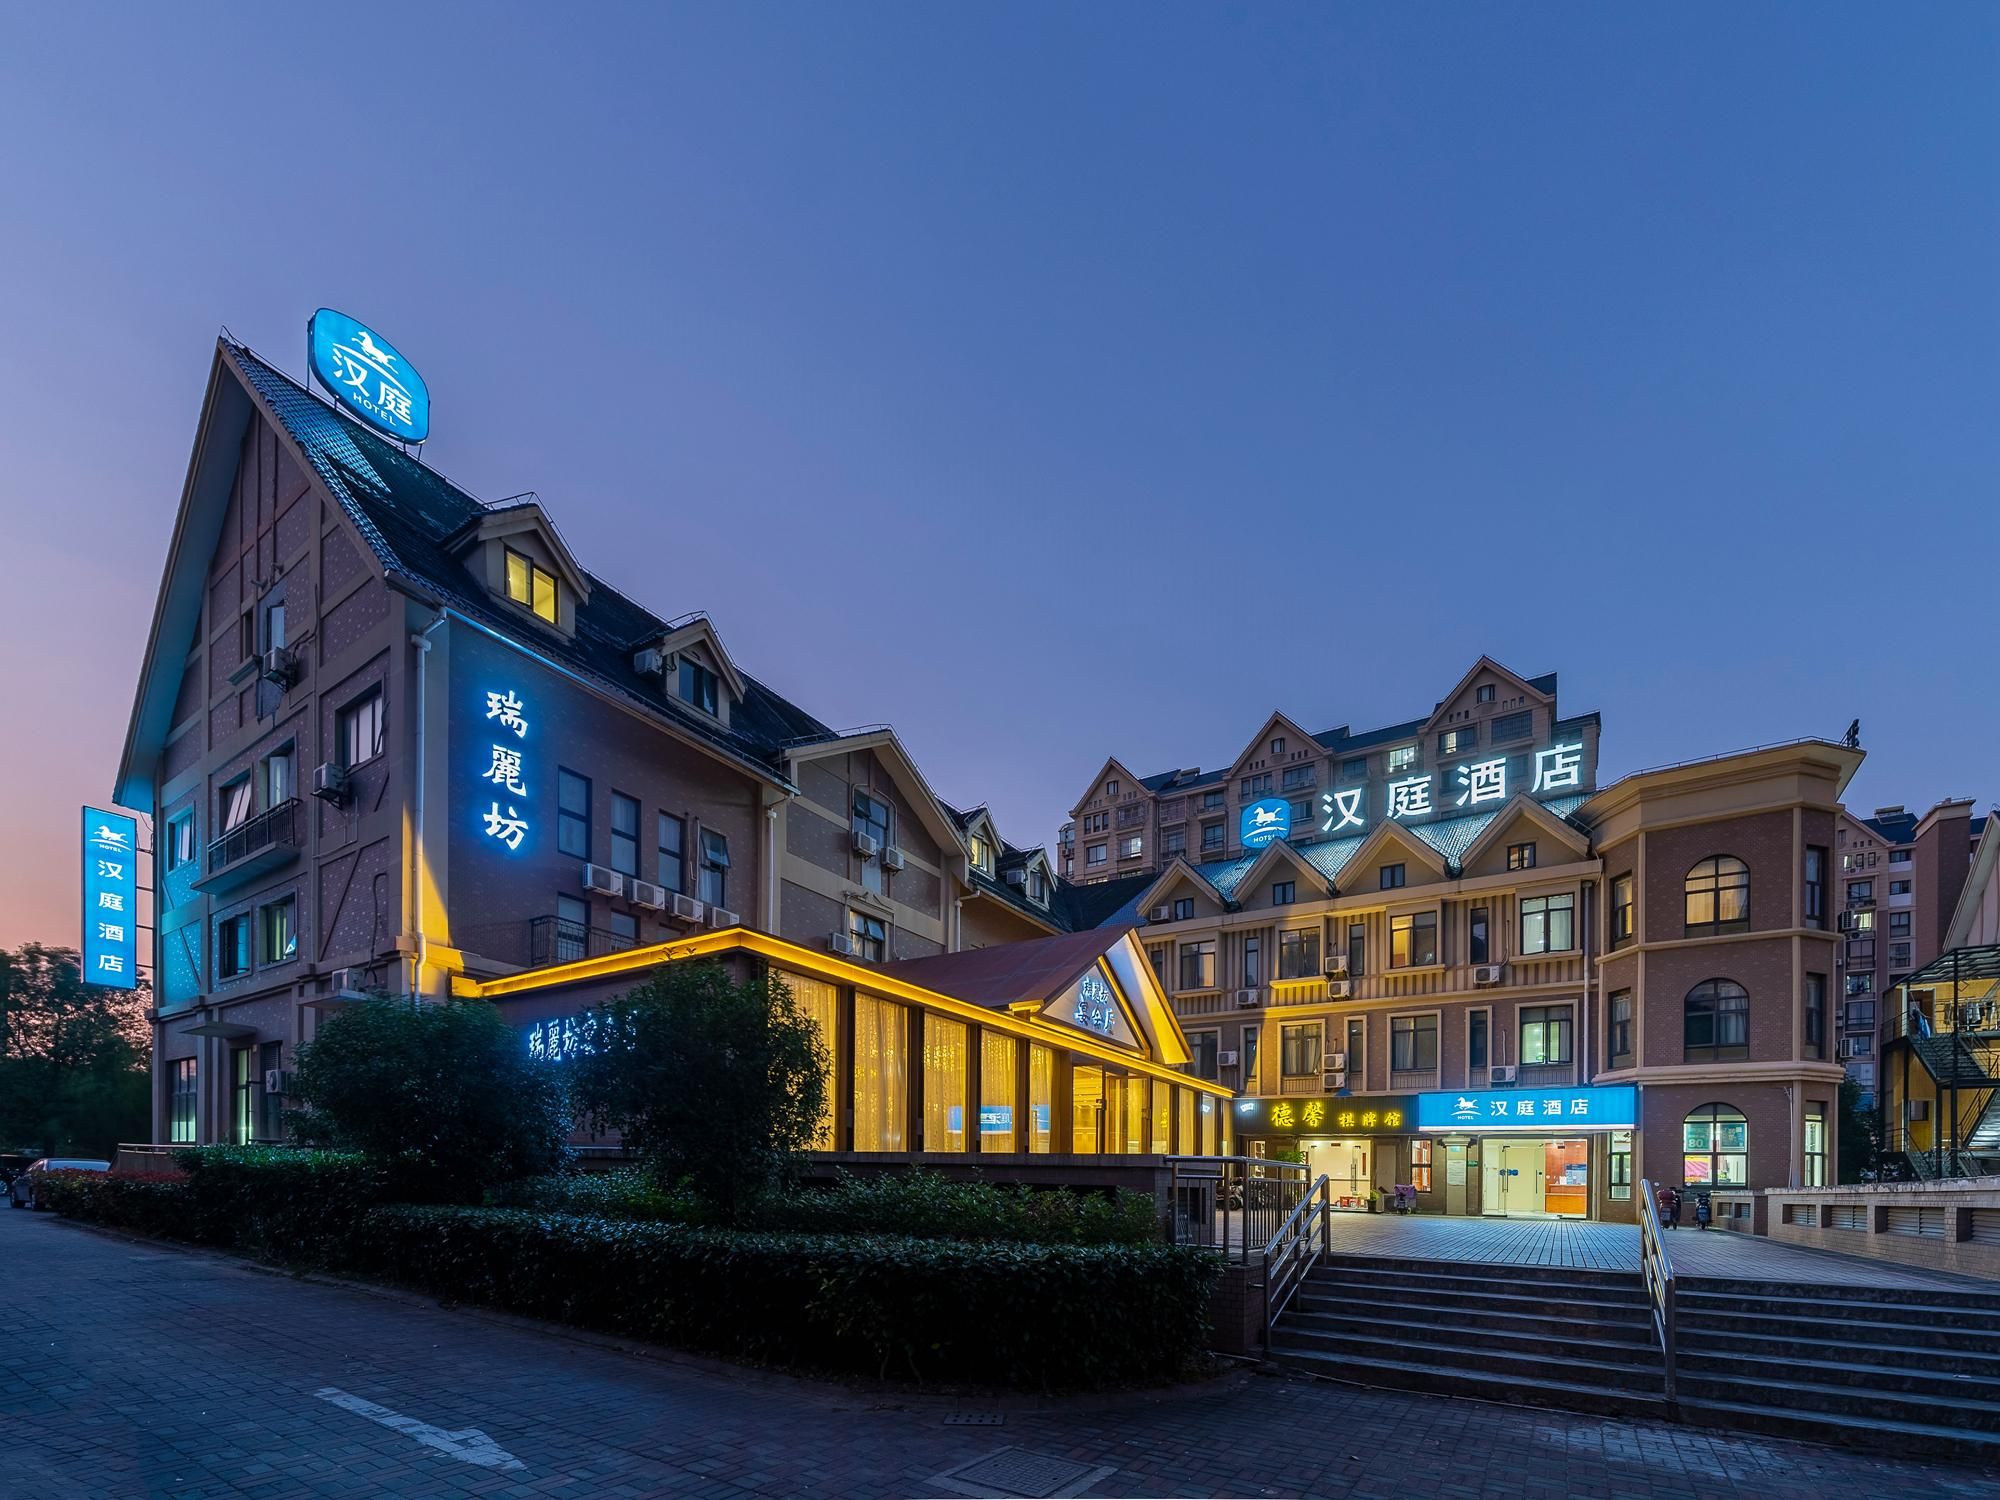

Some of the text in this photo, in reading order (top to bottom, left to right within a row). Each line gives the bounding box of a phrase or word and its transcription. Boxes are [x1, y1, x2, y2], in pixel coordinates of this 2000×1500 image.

[332, 347, 413, 426] 汉庭
[353, 392, 397, 427] HOTEL
[481, 690, 529, 850] 瑞麗坊
[1321, 742, 1583, 832] 汉庭酒店
[98, 844, 122, 853] HOTEL
[98, 859, 124, 973] 汉庭酒店
[1490, 1098, 1589, 1116] 汉庭酒店
